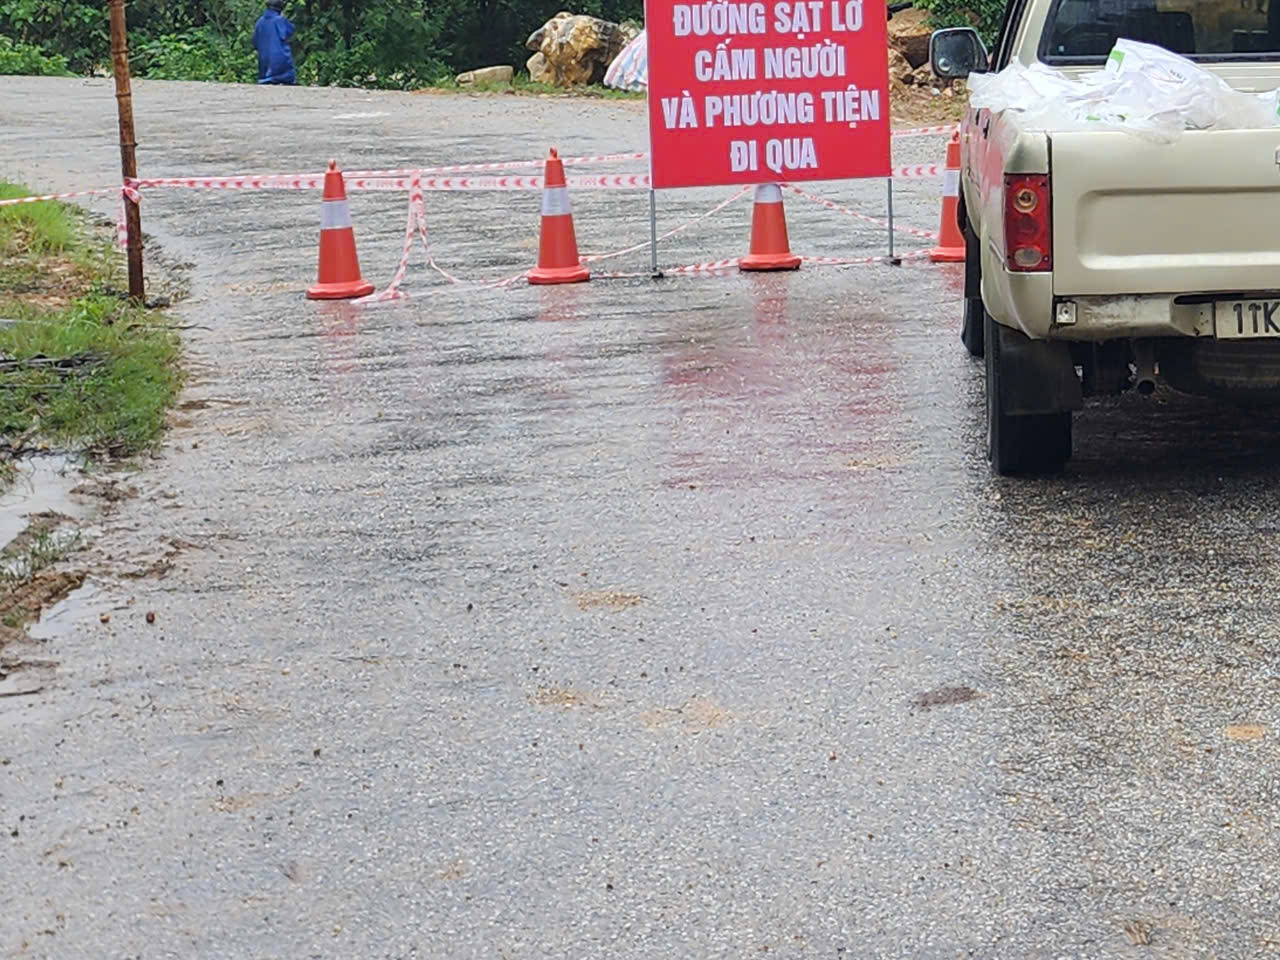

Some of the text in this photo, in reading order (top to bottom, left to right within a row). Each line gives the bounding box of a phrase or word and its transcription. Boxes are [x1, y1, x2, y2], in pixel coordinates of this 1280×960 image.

[774, 1, 823, 39] SẠT
[695, 38, 845, 82] CẤM NGƯỜI
[661, 84, 881, 129] VÀ PHƯƠNG TIỆN
[730, 137, 818, 174] ĐI QUA
